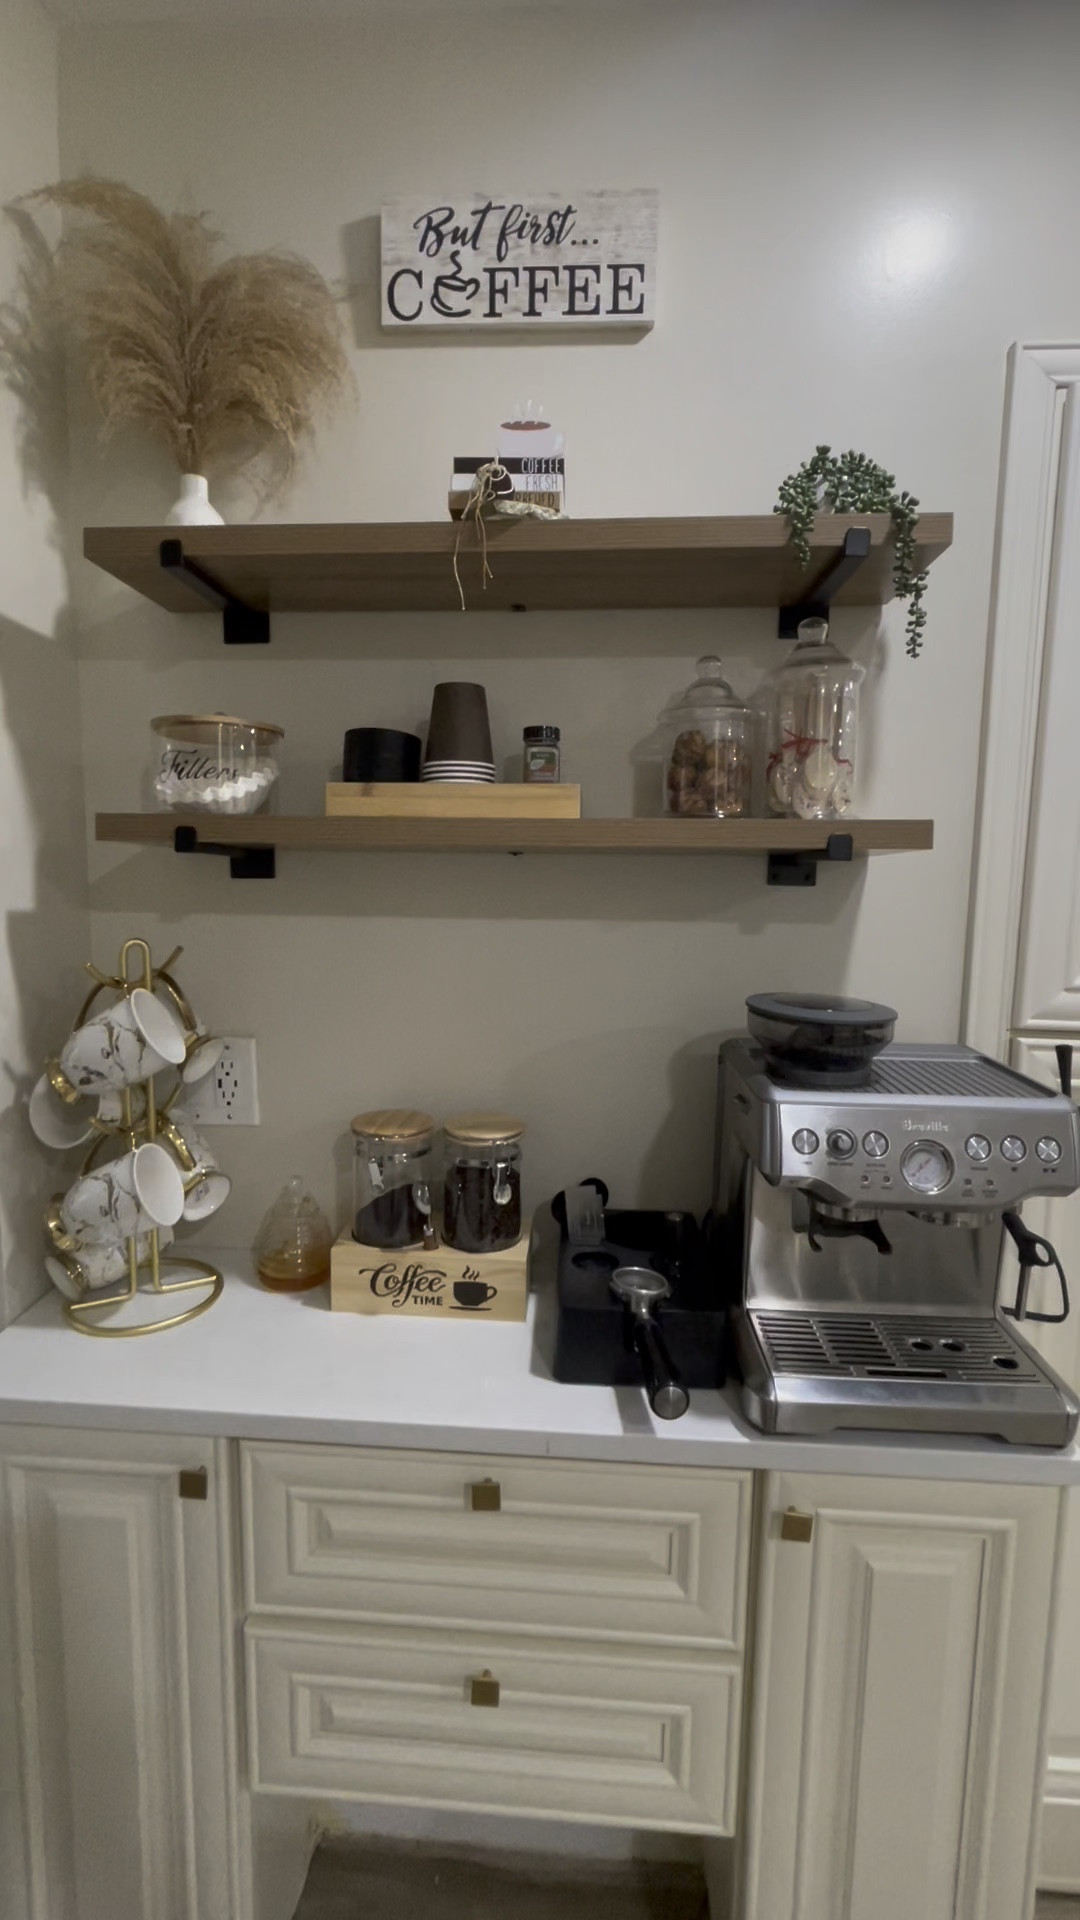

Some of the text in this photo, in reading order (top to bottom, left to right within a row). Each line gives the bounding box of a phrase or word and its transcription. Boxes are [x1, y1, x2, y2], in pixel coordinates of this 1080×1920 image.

[413, 200, 599, 263] But first...
[521, 457, 562, 474] COFFEE
[525, 474, 558, 491] FRESH
[160, 749, 239, 784] Filters
[358, 1262, 447, 1308] Coffee
[412, 1295, 443, 1306] TIME
